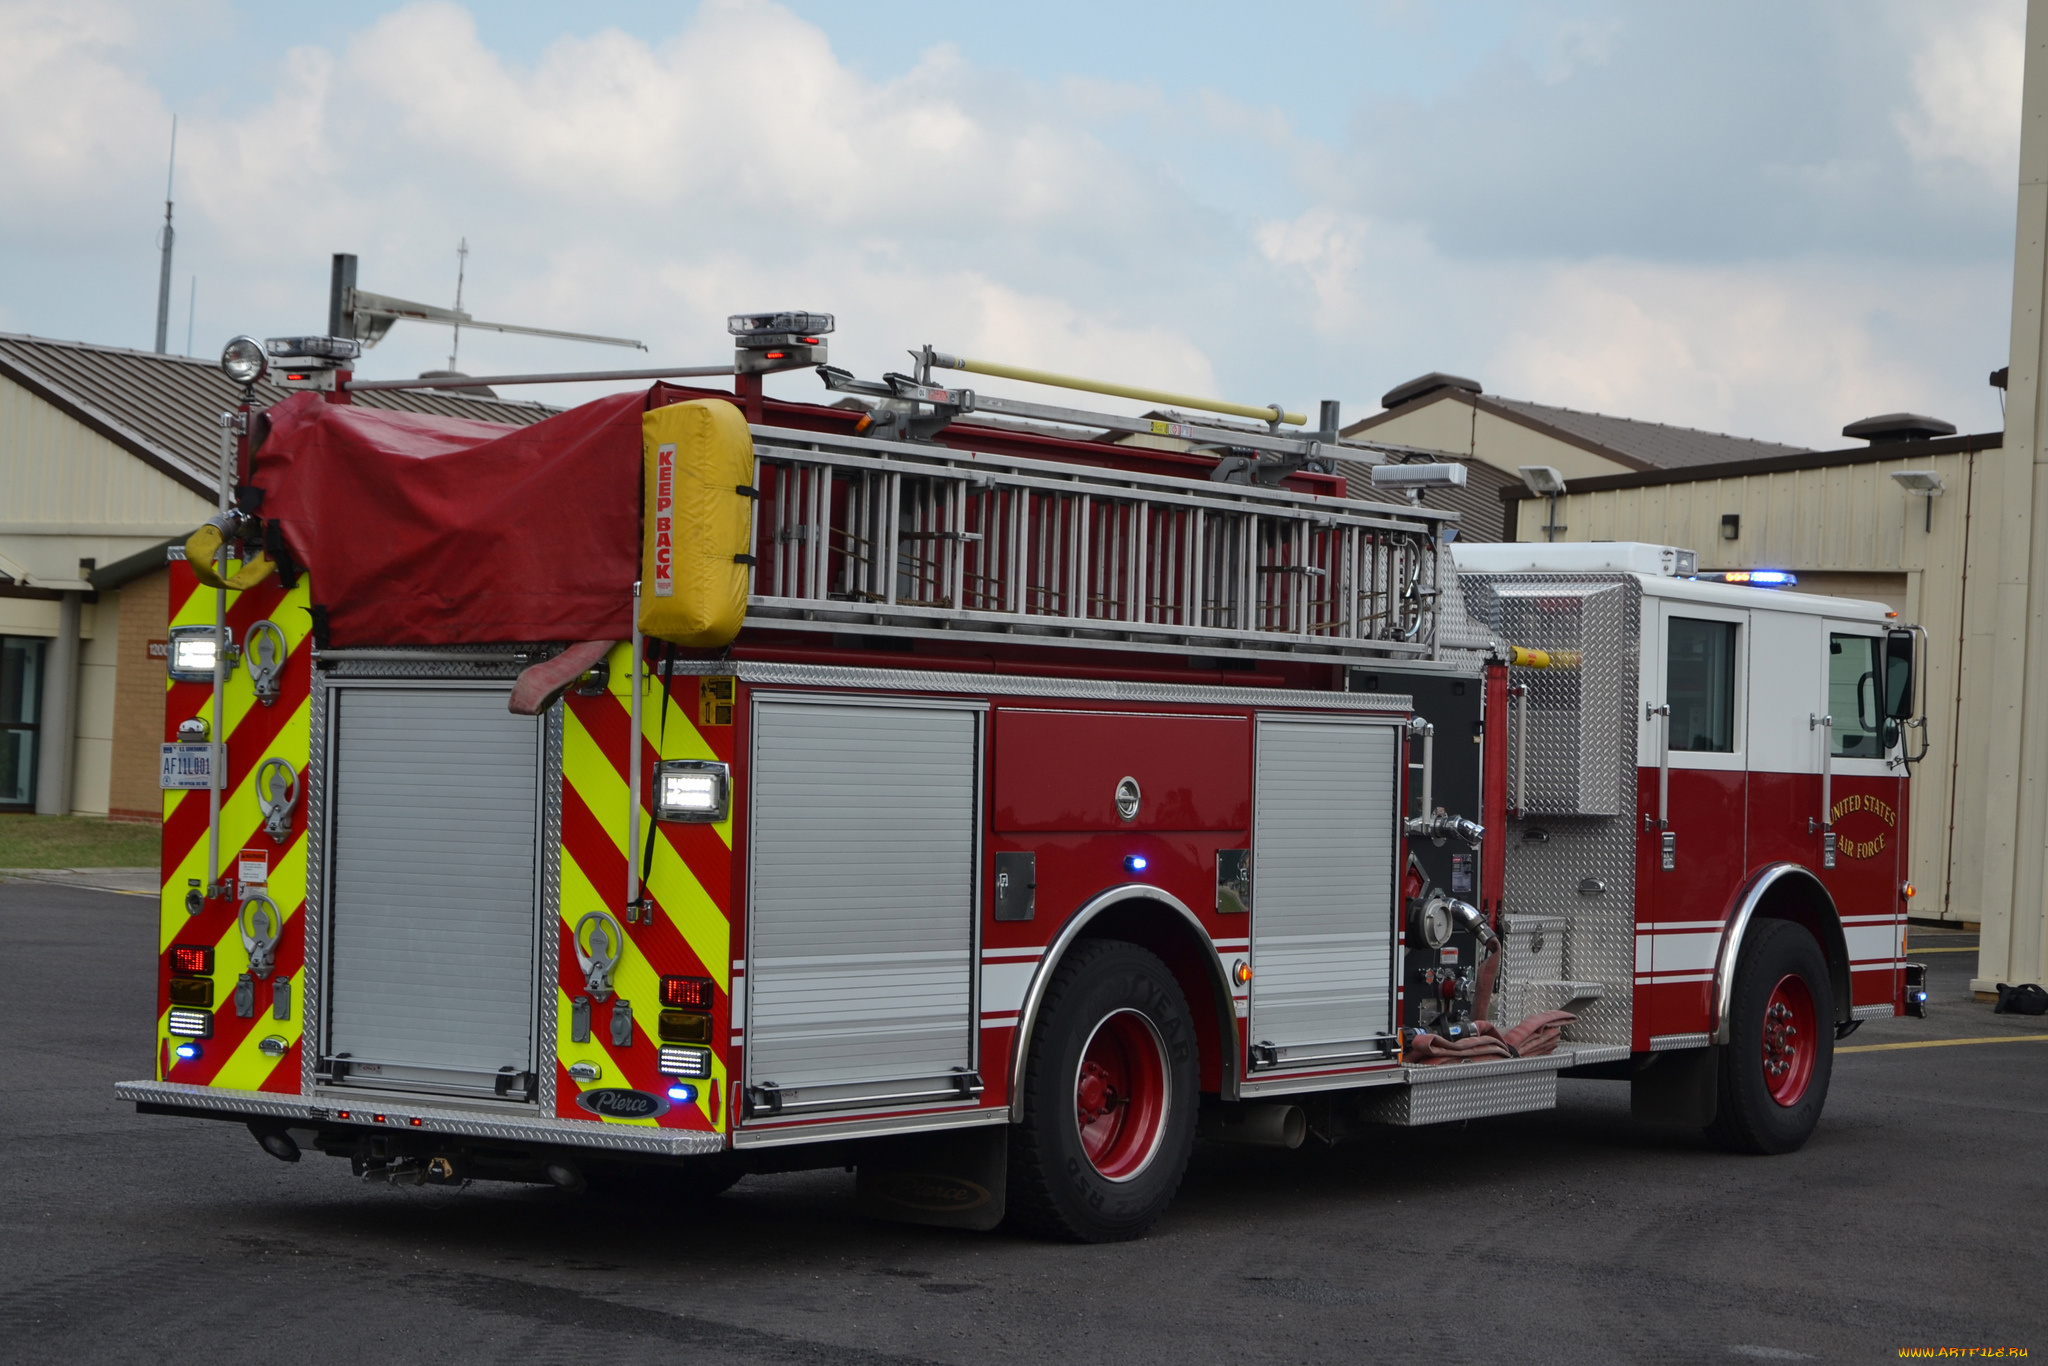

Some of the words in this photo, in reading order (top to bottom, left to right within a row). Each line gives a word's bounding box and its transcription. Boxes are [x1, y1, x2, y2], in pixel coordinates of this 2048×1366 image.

[657, 451, 673, 512] KEEP
[656, 517, 671, 579] BACK
[1864, 794, 1896, 827] STATES
[1837, 834, 1854, 857] AIR
[1857, 832, 1886, 859] FORCE
[595, 1091, 648, 1112] Pierce
